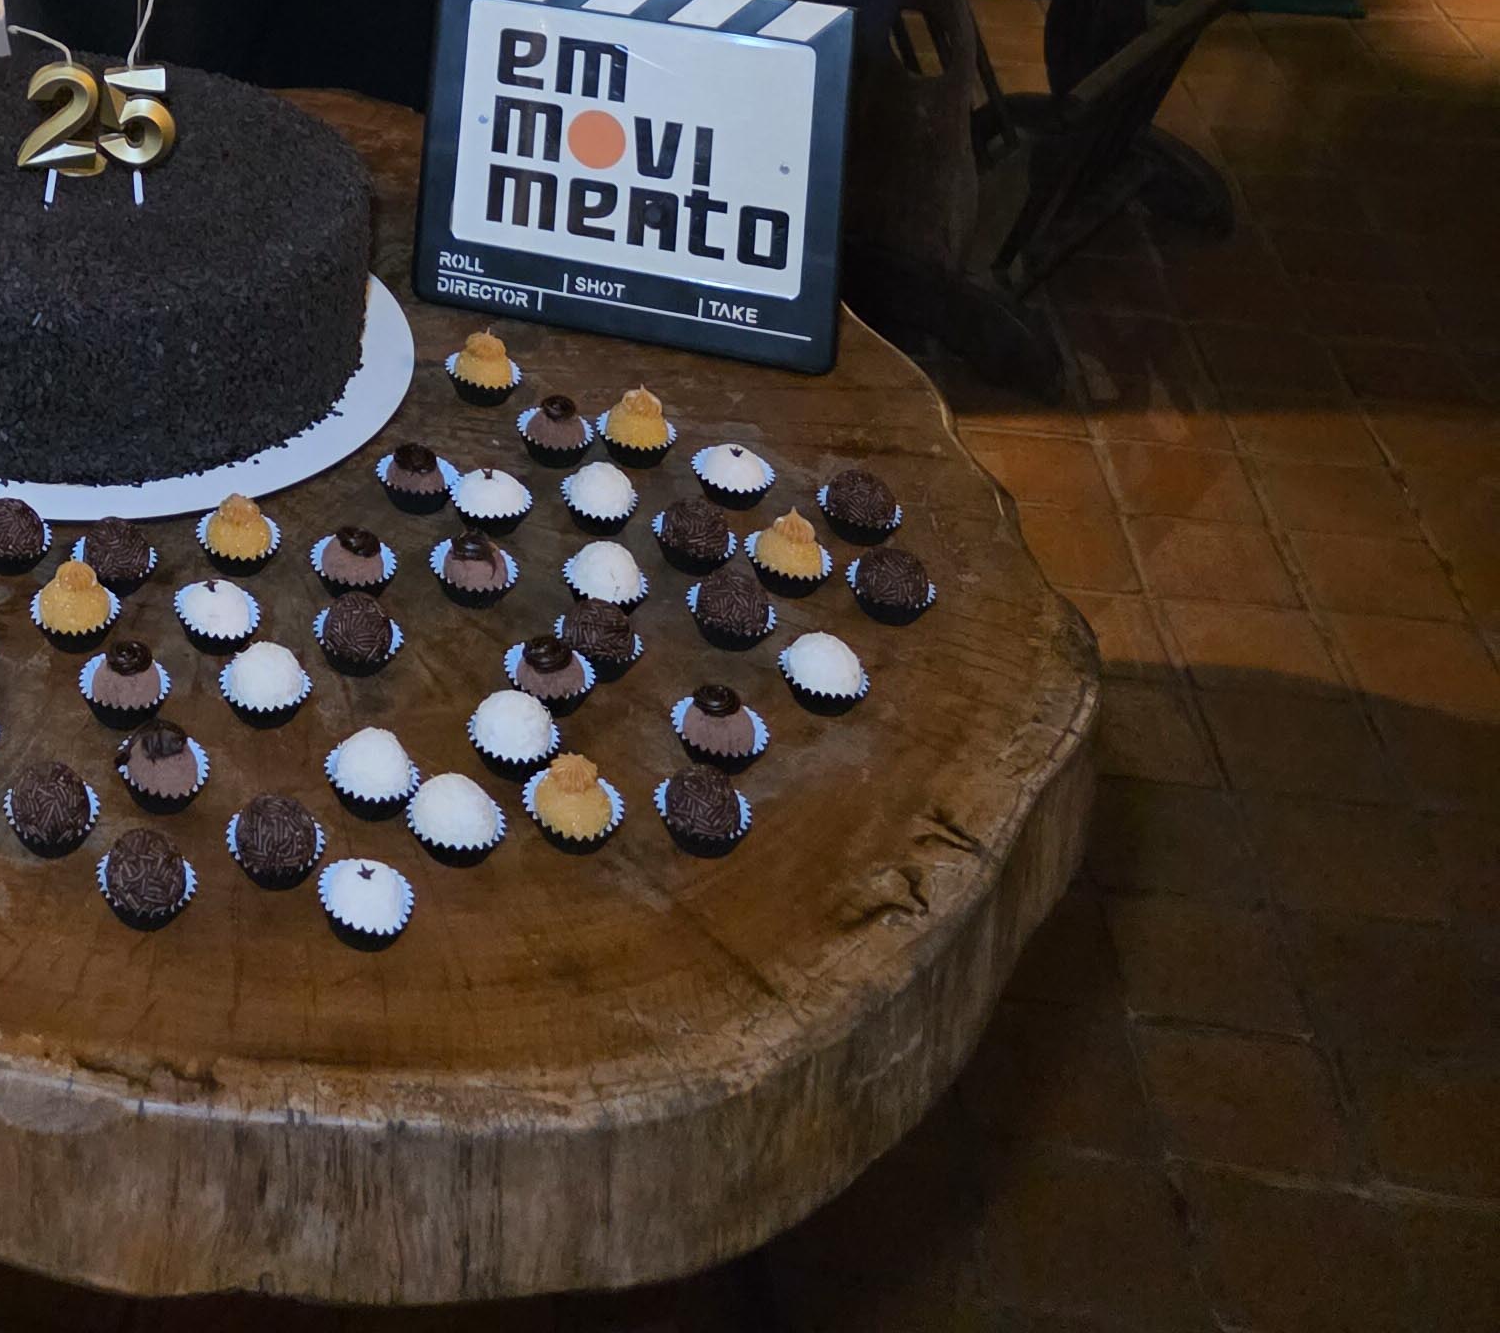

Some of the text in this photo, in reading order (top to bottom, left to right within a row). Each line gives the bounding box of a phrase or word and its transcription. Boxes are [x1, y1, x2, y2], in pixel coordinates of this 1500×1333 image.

[497, 27, 629, 103] em
[17, 62, 177, 169] 25
[491, 95, 715, 187] movi
[485, 163, 791, 271] mento
[438, 250, 485, 275] ROLL
[574, 275, 627, 300] SHOT
[436, 277, 529, 309] DIRECTOR
[708, 300, 759, 325] TAKE
